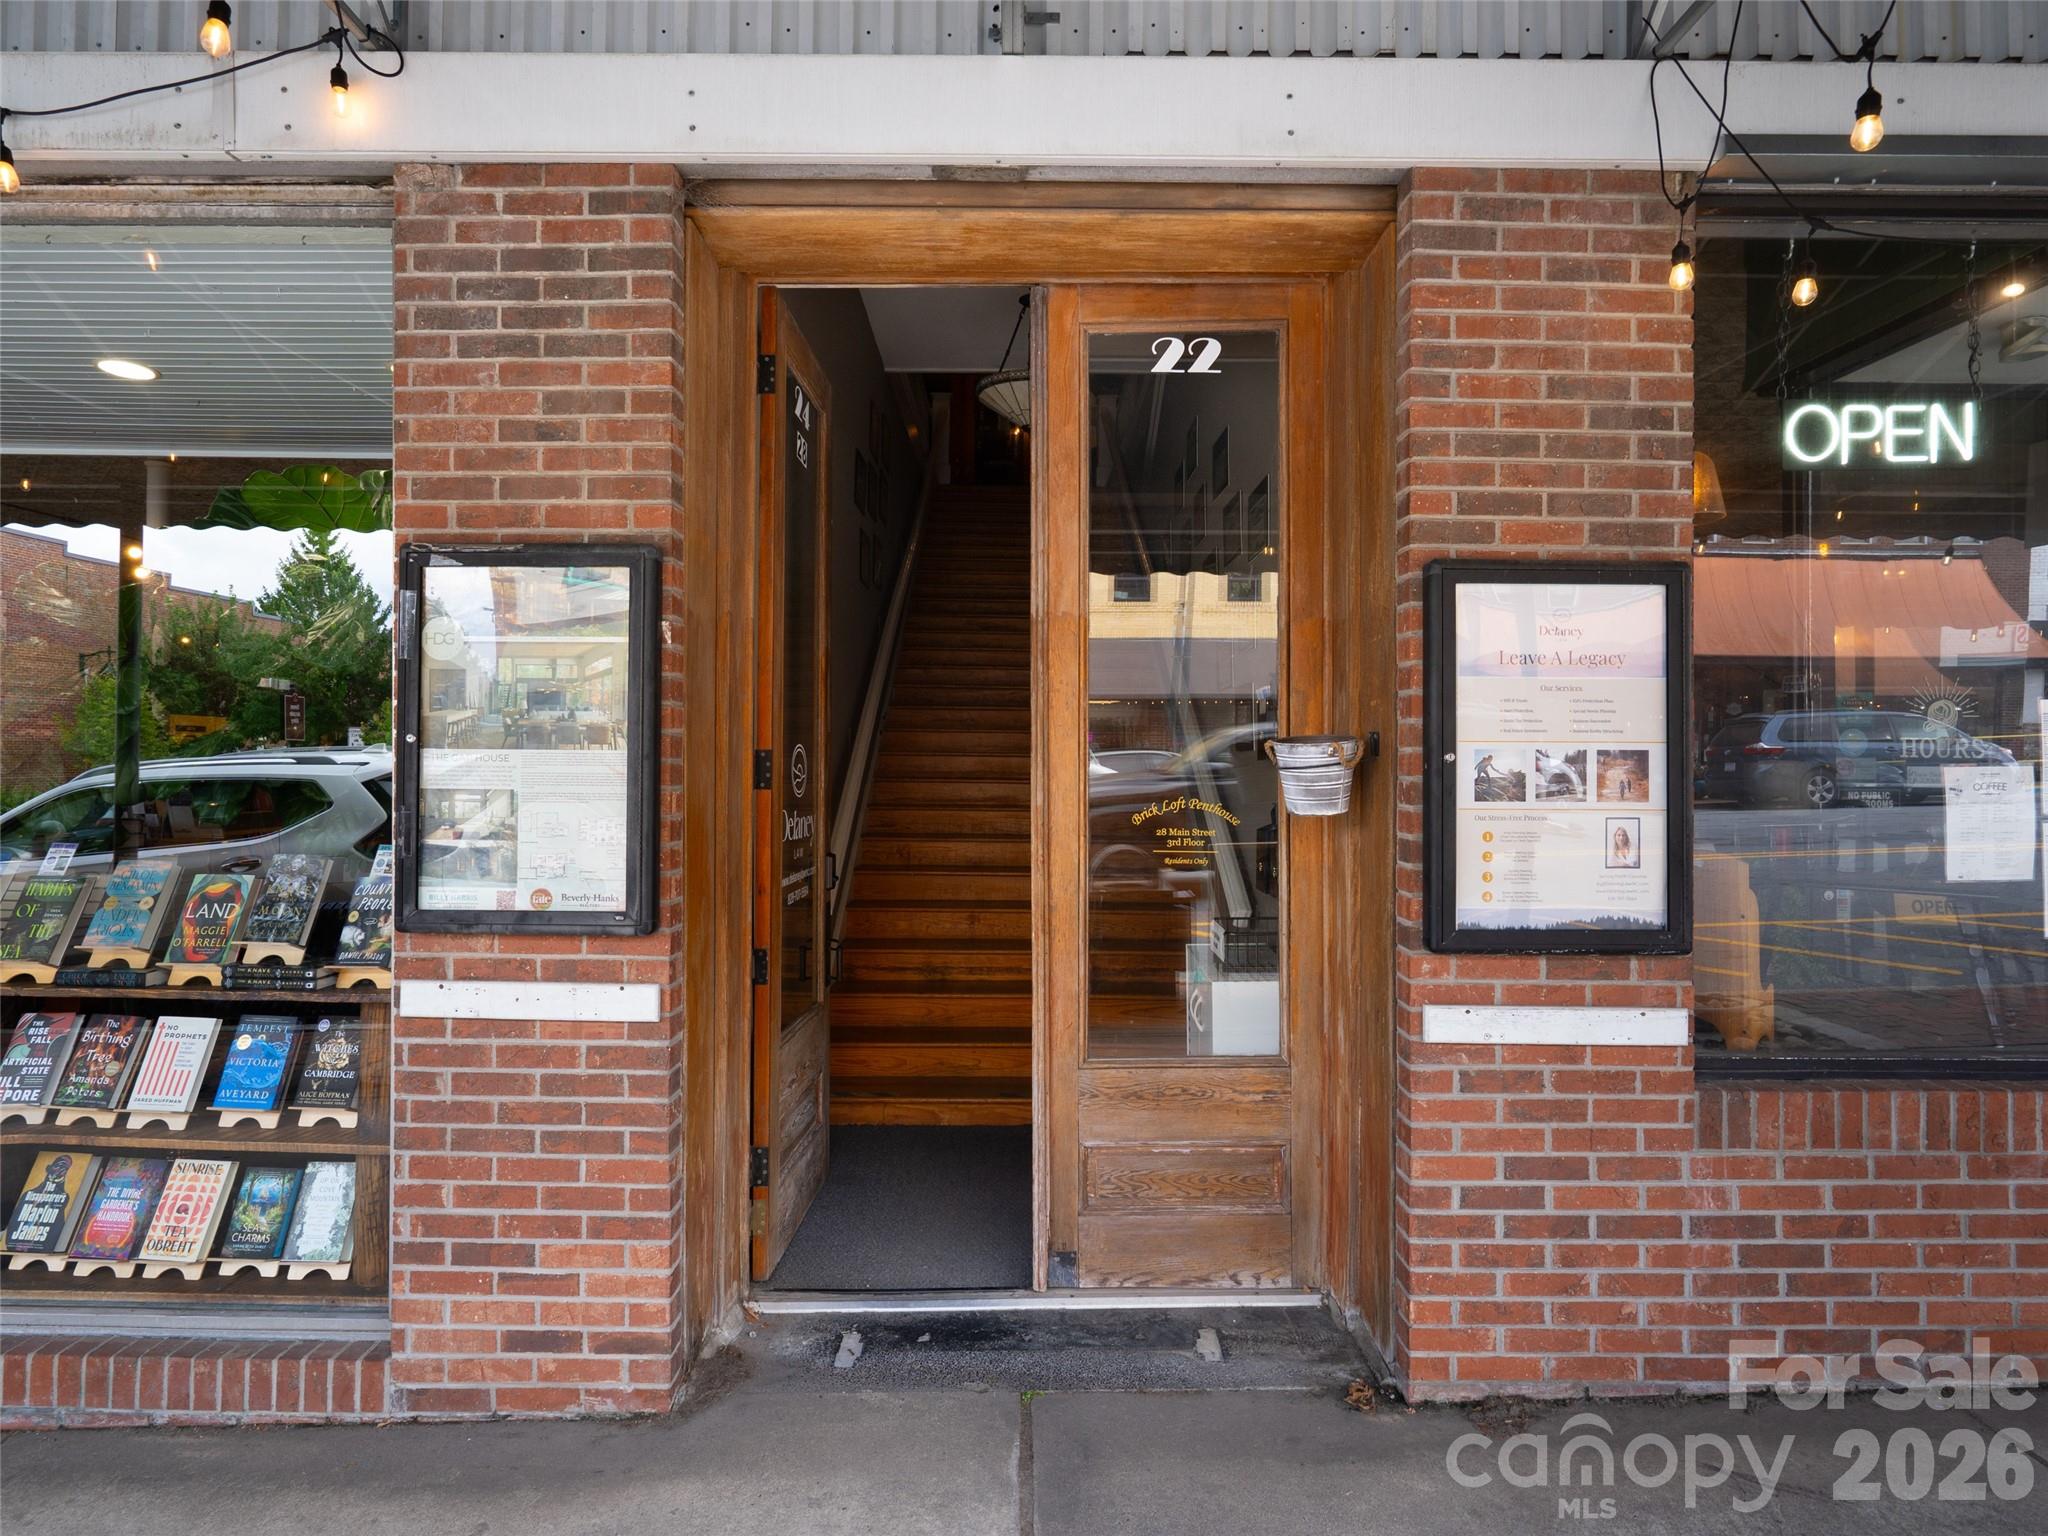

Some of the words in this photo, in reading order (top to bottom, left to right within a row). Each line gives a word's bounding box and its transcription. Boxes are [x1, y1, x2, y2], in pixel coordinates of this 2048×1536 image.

[1151, 337, 1222, 373] 22
[794, 386, 810, 431] 24
[1784, 401, 1977, 465] OPEN
[797, 432, 808, 468] 28
[425, 632, 455, 645] HDG
[1539, 625, 1583, 640] Delaney
[1499, 650, 1546, 666] Leave
[1550, 651, 1562, 665] A
[1568, 650, 1626, 670] Legacy
[1555, 684, 1583, 692] Services
[1901, 739, 1985, 758] HOURS
[1973, 782, 2007, 791] COFFEE
[1848, 792, 1859, 800] NO
[1861, 791, 1890, 800] PUBLIC
[1131, 802, 1164, 826] Brick
[1162, 796, 1186, 813] Loft
[1188, 798, 1240, 826] Penthouse
[1474, 814, 1487, 822] Our
[782, 809, 816, 847] Delaney
[1156, 828, 1167, 836] 28
[1169, 828, 1190, 836] Main
[1191, 828, 1216, 837] Street
[1166, 838, 1181, 848] 3rd
[1183, 838, 1205, 847] Floor
[1164, 857, 1193, 865] Residents
[1194, 857, 1208, 866] Only
[25, 882, 74, 897] HABITS
[354, 883, 392, 896] COUNT
[16, 903, 40, 918] OF
[185, 903, 240, 918] LAND
[1912, 899, 1952, 914] OPEN
[28, 924, 56, 938] THE
[183, 926, 226, 935] MAGGIE
[172, 938, 227, 947] O'FARRELL
[338, 952, 361, 960] DANIEL
[363, 952, 386, 960] MASON
[106, 1019, 120, 1027] The
[240, 1023, 289, 1033] TEMPEST
[28, 1027, 50, 1035] RISE
[164, 1032, 208, 1040] PROPHETS
[30, 1036, 51, 1044] FALL
[82, 1030, 133, 1048] Birthing
[315, 1043, 359, 1054] WITCHES
[86, 1049, 112, 1062] Tree
[3, 1058, 53, 1066] ARTIFICIAL
[229, 1057, 279, 1067] VICTORIA
[21, 1066, 50, 1075] STATE
[304, 1069, 355, 1078] CAMBRIDGE
[68, 1073, 110, 1085] Amanda
[65, 1086, 101, 1098] Peters
[219, 1089, 269, 1099] AVEYARD
[176, 1161, 224, 1175] SUNRISE
[44, 1181, 56, 1191] The
[107, 1187, 120, 1197] THE
[120, 1187, 143, 1199] DIVINE
[18, 1203, 59, 1224] Marlon
[11, 1221, 50, 1241] James
[242, 1224, 259, 1232] SEA
[231, 1232, 271, 1244] CHARMS
[147, 1239, 197, 1253] OBREHT
